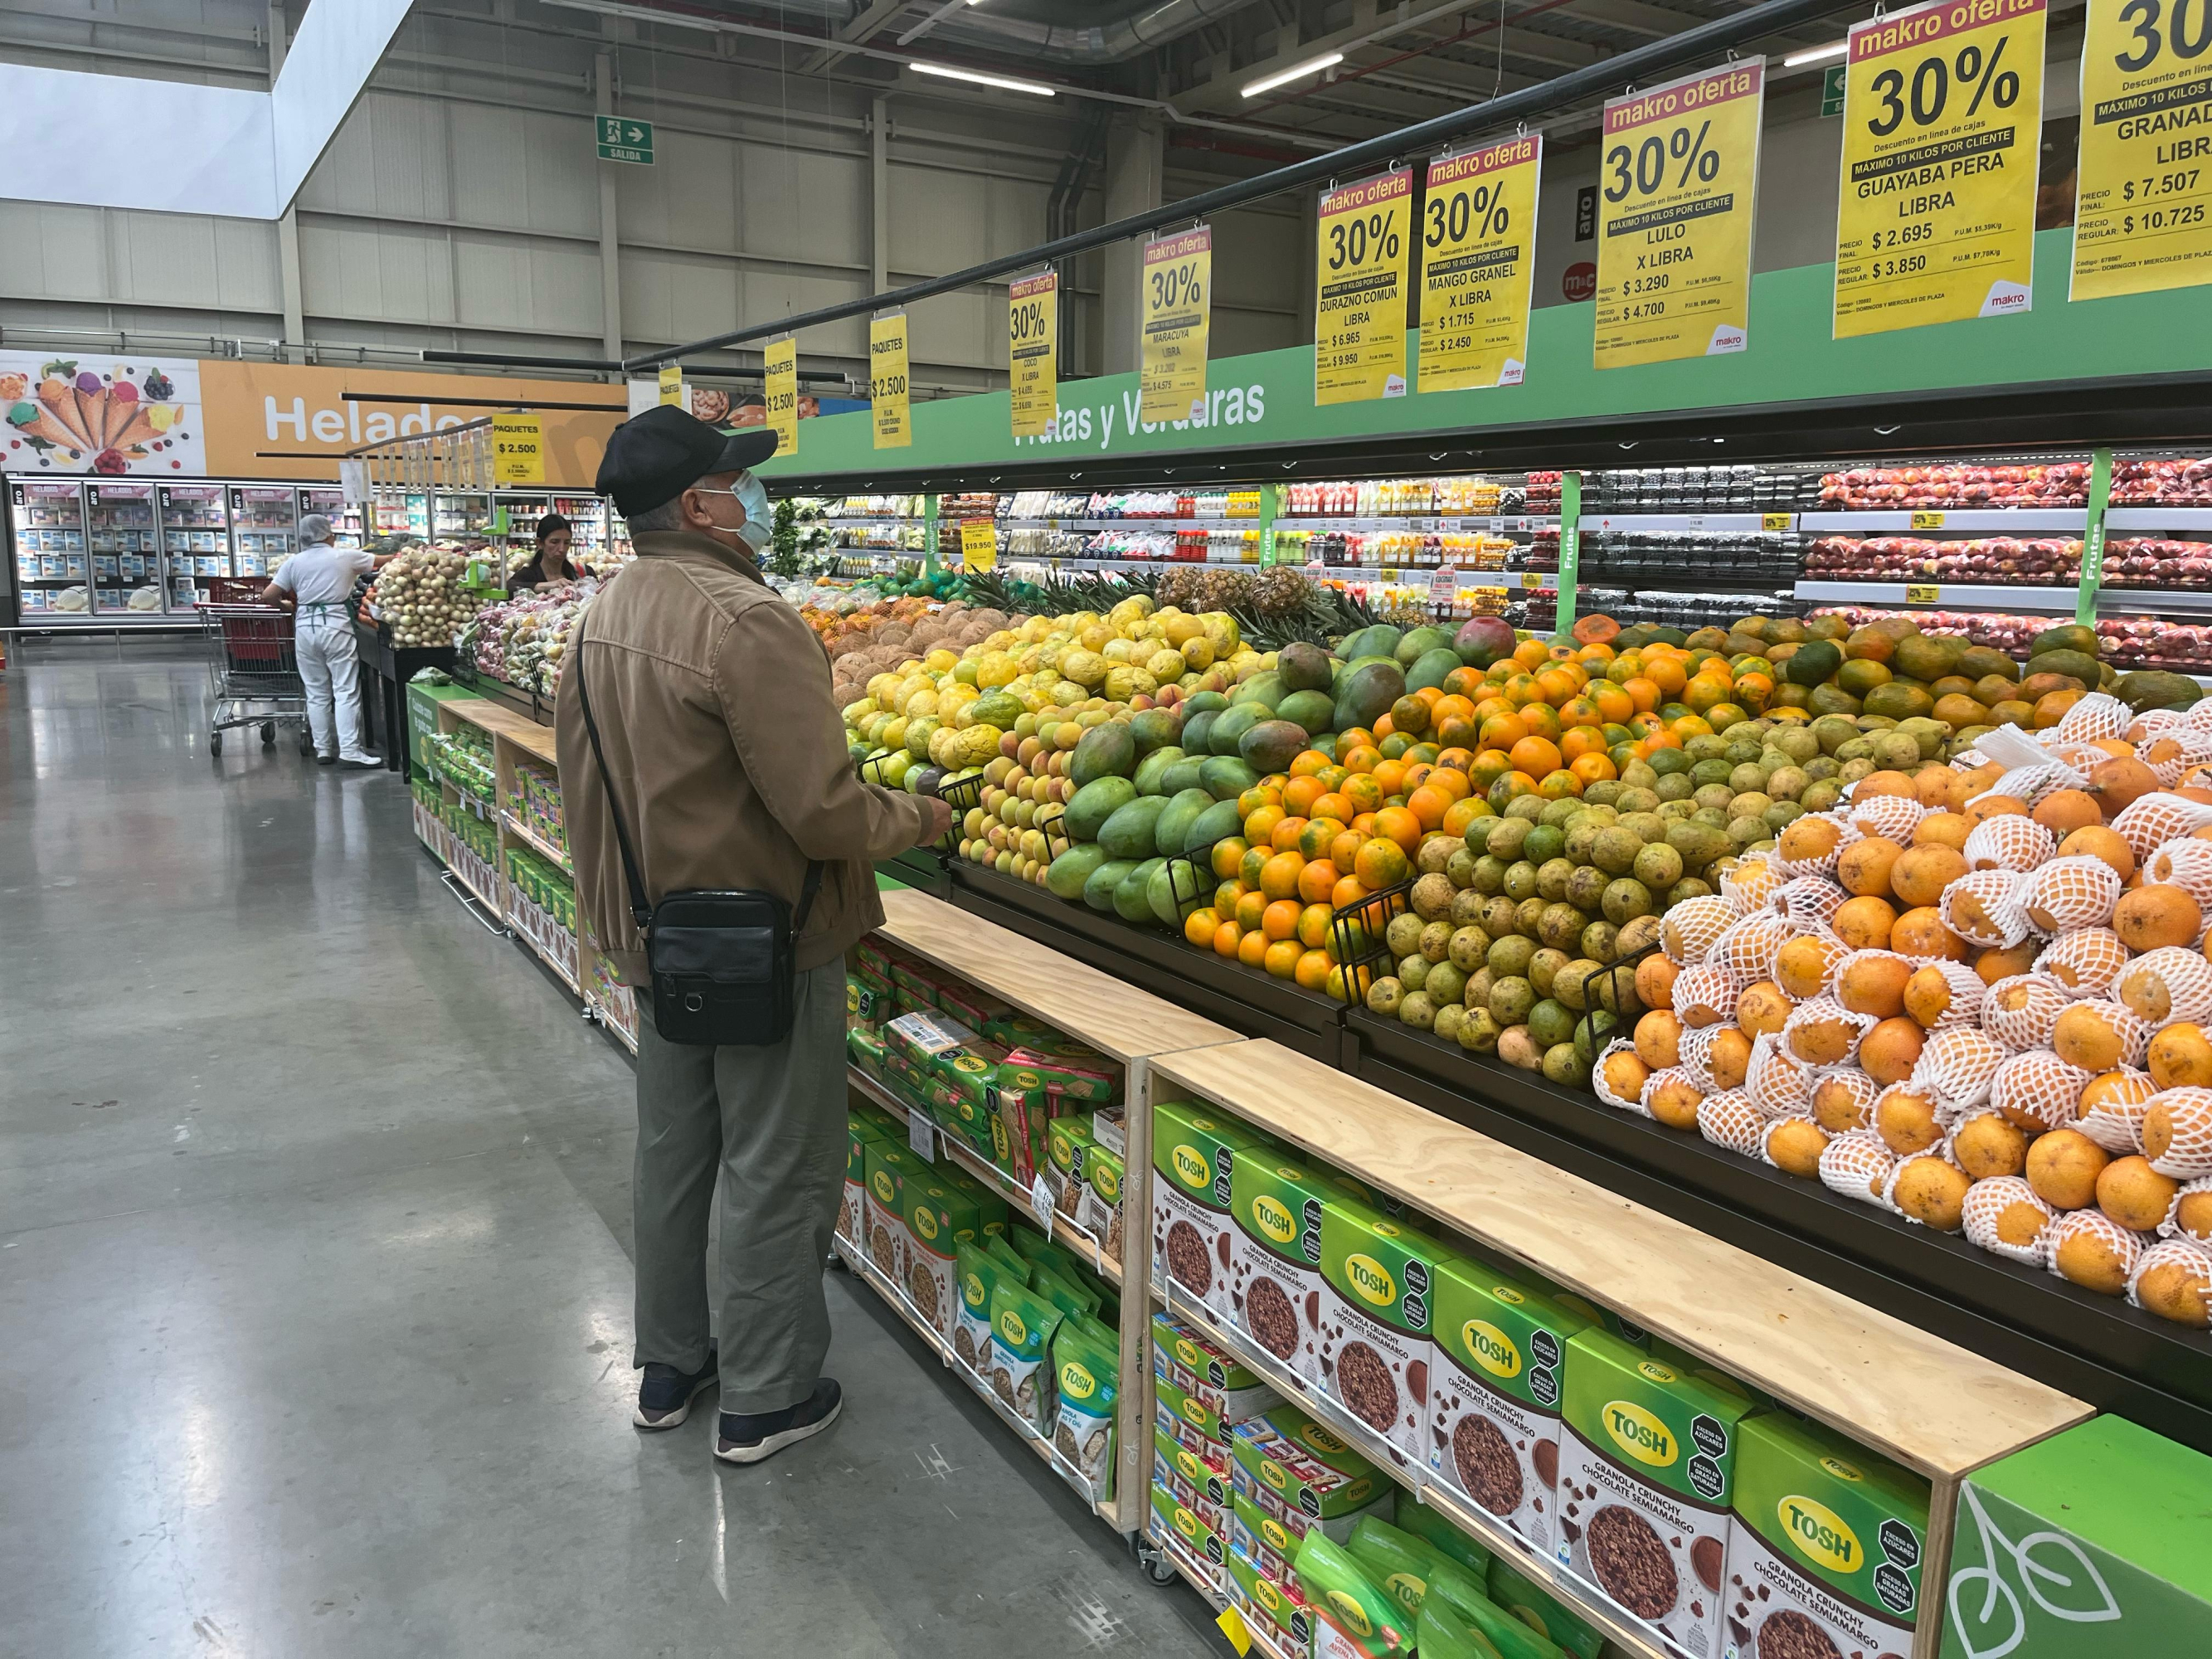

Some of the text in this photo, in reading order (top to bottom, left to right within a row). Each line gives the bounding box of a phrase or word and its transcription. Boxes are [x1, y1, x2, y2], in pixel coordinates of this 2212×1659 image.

[1859, 15, 1942, 56] makro
[1868, 36, 2020, 136] 30%
[2122, 69, 2191, 91] Descuento en
[1612, 73, 1750, 128] makro oferta
[2151, 83, 2206, 105] 10 KILOS
[1874, 119, 1986, 153] Descuento en de cajas
[1896, 129, 2010, 165] 10 KILOS POR CLIENTE
[610, 148, 641, 162] SALIDA
[1432, 141, 1532, 182] makro oferta
[1604, 120, 1719, 202] 30%
[1858, 152, 2005, 199] GUAYABA PERA
[2080, 169, 2200, 202] PRECIO 7.507
[1324, 177, 1406, 213] makro oferta
[1898, 191, 1956, 218] LIBRA
[1425, 181, 1509, 248] 30%
[1651, 210, 1675, 221] KILOS
[1676, 205, 1693, 216] POR
[1695, 197, 1730, 212] CLIENTE
[2078, 205, 2205, 230] PRECIO 10.725
[1329, 210, 1399, 270] 30%
[1647, 223, 1685, 245] LULO
[1887, 222, 1932, 247] 2.695
[1147, 235, 1207, 261] makro oferta
[1460, 248, 1517, 266] KILOS POR CLIENTE
[1636, 246, 1694, 270] X LIBRA
[1885, 255, 1927, 275] 3.850
[1012, 277, 1053, 297] makro oferta
[1151, 262, 1200, 310] 30%
[1428, 264, 1516, 291] MANGO GRANEL
[1634, 274, 1669, 294] 3.290
[1320, 286, 1398, 313] DURAZNO COMUN
[1449, 289, 1491, 308] X LIBRA
[1633, 301, 1665, 319] 4.700
[1991, 294, 2025, 306] makro
[1011, 301, 1045, 341] 30%
[1344, 311, 1370, 327] LIBRA
[1448, 312, 1475, 328] 1.715
[872, 338, 902, 355] PAQUETES
[1153, 328, 1189, 344] MARACUYA
[1339, 332, 1360, 345] 6.965
[1447, 336, 1471, 349] 2.450
[1715, 336, 1742, 347] makro
[1023, 358, 1038, 367] COCO
[1162, 346, 1181, 358] LIBRA
[1339, 353, 1358, 365] 9.950
[765, 360, 793, 377] PAQUETES
[879, 375, 906, 397] 2.500
[1157, 381, 1172, 391] 4.575
[773, 392, 794, 411] 2.500
[264, 396, 489, 445] Helado
[493, 425, 538, 433] PAQUETES
[1100, 404, 1116, 450] y
[508, 444, 537, 453] 2.500
[965, 541, 992, 551] $19.950
[1263, 528, 1271, 562] Frutas
[1564, 527, 1575, 569] Frutas
[2086, 523, 2101, 580] Frutas
[1018, 1076, 1037, 1084] TOSH
[1055, 1141, 1069, 1161] TOSH
[1177, 1151, 1205, 1180] TOSH
[877, 1176, 892, 1197] TOSH
[1099, 1172, 1115, 1191] TOSH
[917, 1212, 935, 1233] TOSH
[1163, 1194, 1219, 1233] CHOCOLATE SEMIAMARGO
[1190, 1204, 1213, 1219] CRUNCHY
[1257, 1203, 1290, 1235] TOSH
[1242, 1248, 1308, 1291] CHOCOLATE SEMIAMARGO
[1249, 1244, 1299, 1278] GRANOLA CRUNCHY
[1351, 1262, 1389, 1297] TOSH
[1004, 1316, 1023, 1340] TOSH
[1333, 1309, 1408, 1360] CHOCOLATE SEMIAMARGO
[1341, 1306, 1399, 1345] GRANOLA CRUNCHY
[1179, 1343, 1195, 1361] TOSH
[1470, 1327, 1513, 1369] TOSH
[1067, 1368, 1091, 1392] TOSH
[1643, 1364, 1671, 1380] TOSH
[1448, 1377, 1535, 1438] CHOCOLATE SEMIAMARGO
[1457, 1375, 1524, 1422] GRANOLA CRUNCHY
[1186, 1402, 1203, 1420] TOSH
[1308, 1427, 1343, 1451] TOSH
[1612, 1409, 1667, 1457] TOSH
[1694, 1430, 1723, 1449] AZUCARES
[1179, 1456, 1195, 1475] TOSH
[1264, 1464, 1283, 1486] TOSH
[1695, 1468, 1717, 1484] GRASAS
[1826, 1458, 1857, 1478] TOSH
[1350, 1483, 1369, 1497] TOSH
[1595, 1462, 1680, 1515] GRANOLA CRUNCHY
[1689, 1472, 1720, 1493] SATURADAS
[1582, 1465, 1694, 1534] CHOCOLATE SEMIAMARGO
[1178, 1513, 1194, 1532] TOSH
[1265, 1523, 1284, 1545] TOSH
[1789, 1505, 1852, 1563] TOSH
[1883, 1536, 1915, 1559] AZUCARES
[1259, 1584, 1276, 1606] TOSH
[1753, 1561, 1879, 1651] CHOCOLATE SEMIAMARGO
[1769, 1561, 1864, 1628] GRANOLA CRUNCHY
[1330, 1597, 1367, 1632] TOSH
